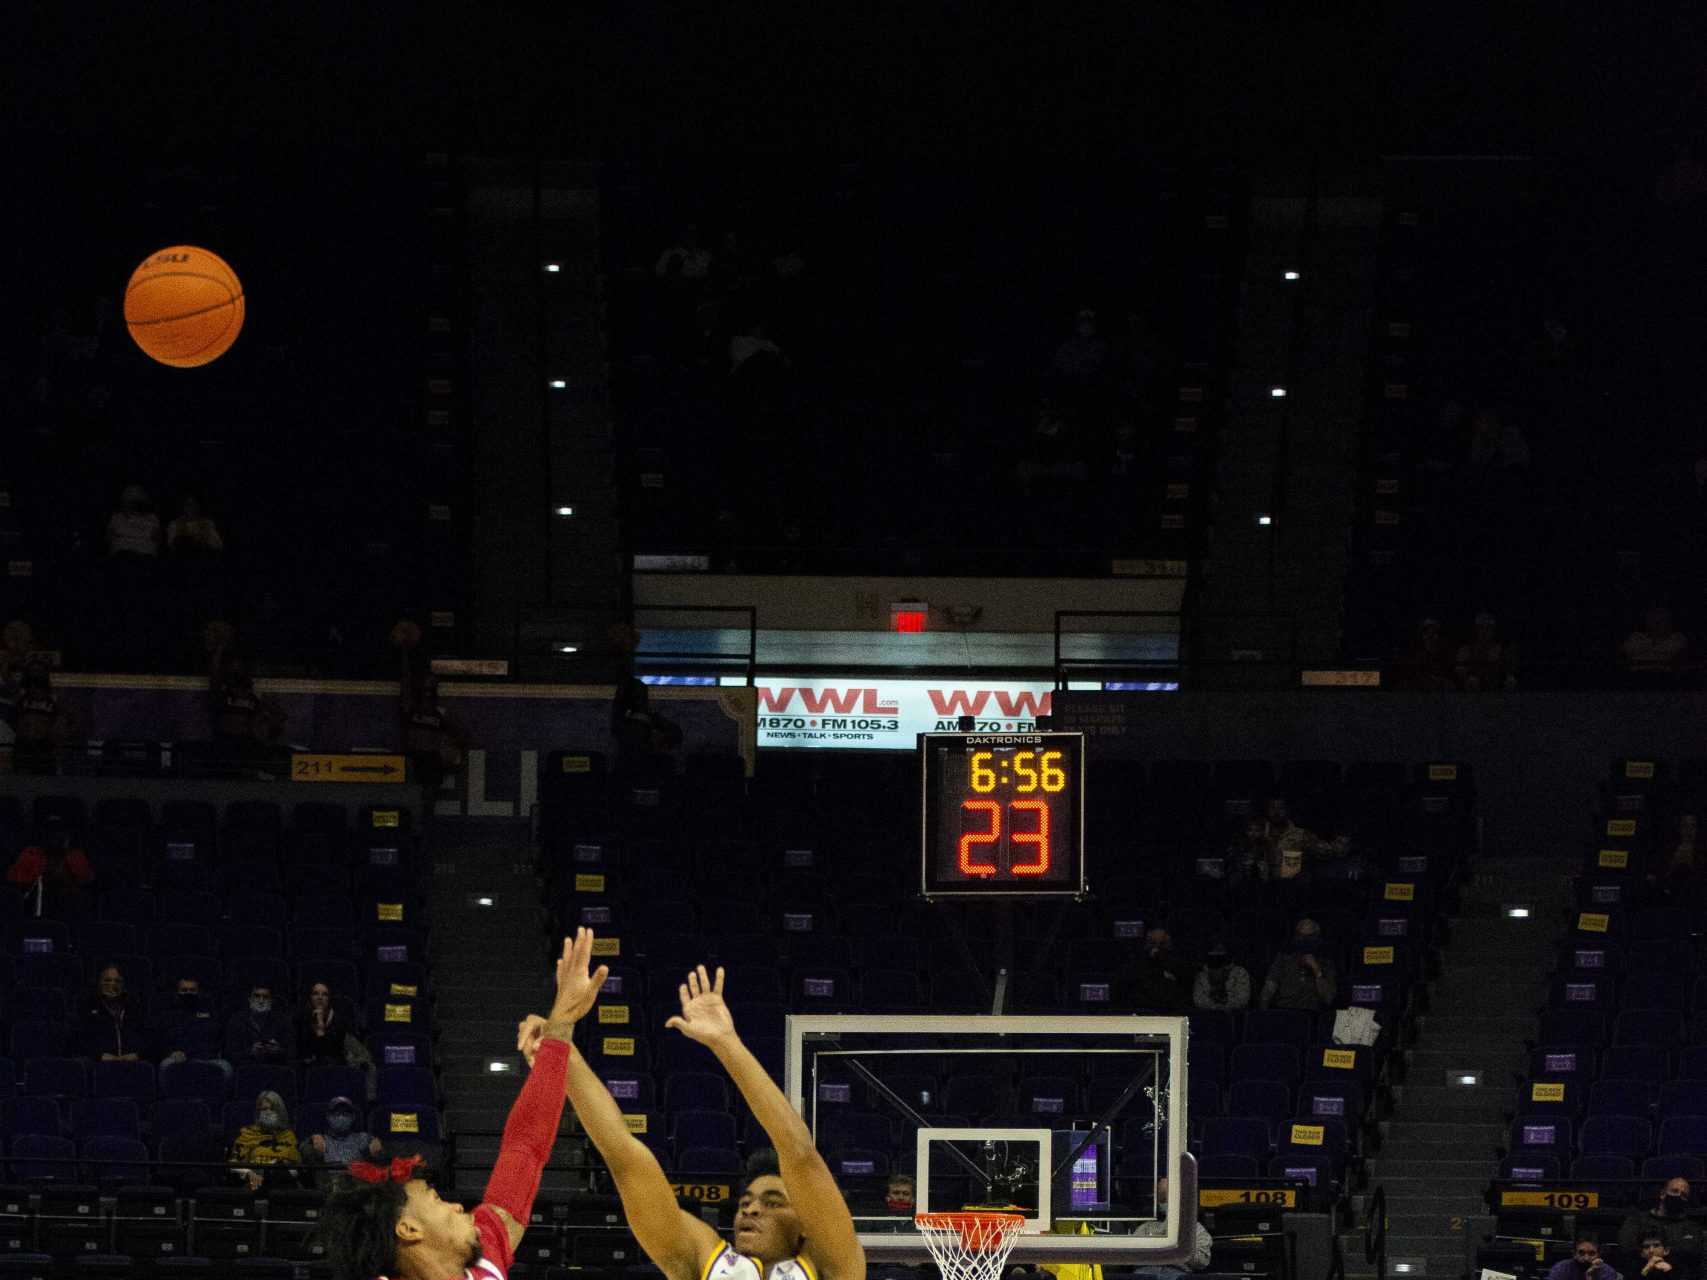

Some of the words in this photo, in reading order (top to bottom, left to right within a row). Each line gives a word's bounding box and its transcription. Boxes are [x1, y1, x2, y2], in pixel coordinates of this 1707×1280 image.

[966, 736, 1043, 744] DAKTRONICS
[970, 751, 1066, 793] 6:56
[959, 799, 1050, 877] 23
[1239, 1191, 1287, 1205] 108
[1544, 1193, 1590, 1209] 109
